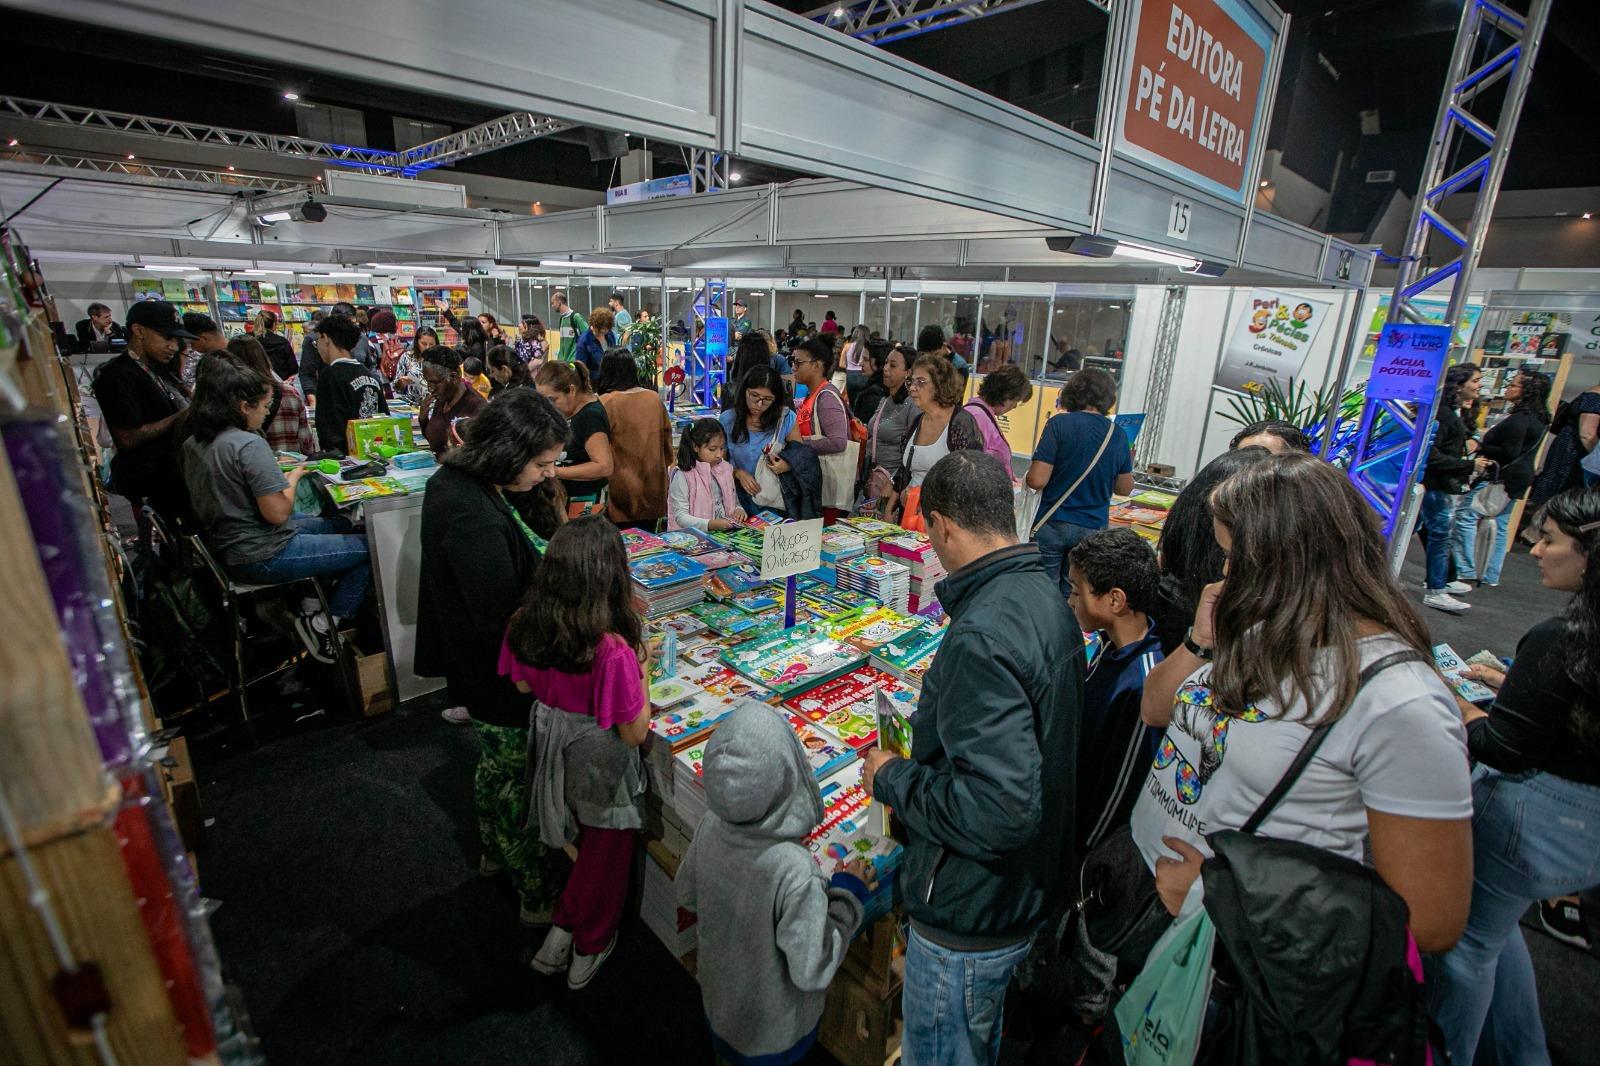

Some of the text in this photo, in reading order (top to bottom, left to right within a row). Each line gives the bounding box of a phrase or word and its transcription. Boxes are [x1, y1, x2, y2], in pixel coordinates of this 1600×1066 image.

[1166, 3, 1243, 102] EDITORA
[1135, 61, 1245, 167] PÉ DA LETRA
[1173, 202, 1190, 234] 15
[1253, 297, 1280, 310] Peri
[1275, 305, 1289, 321] &
[1390, 356, 1425, 368] ÁGUA
[1379, 366, 1433, 378] POTÁVEL
